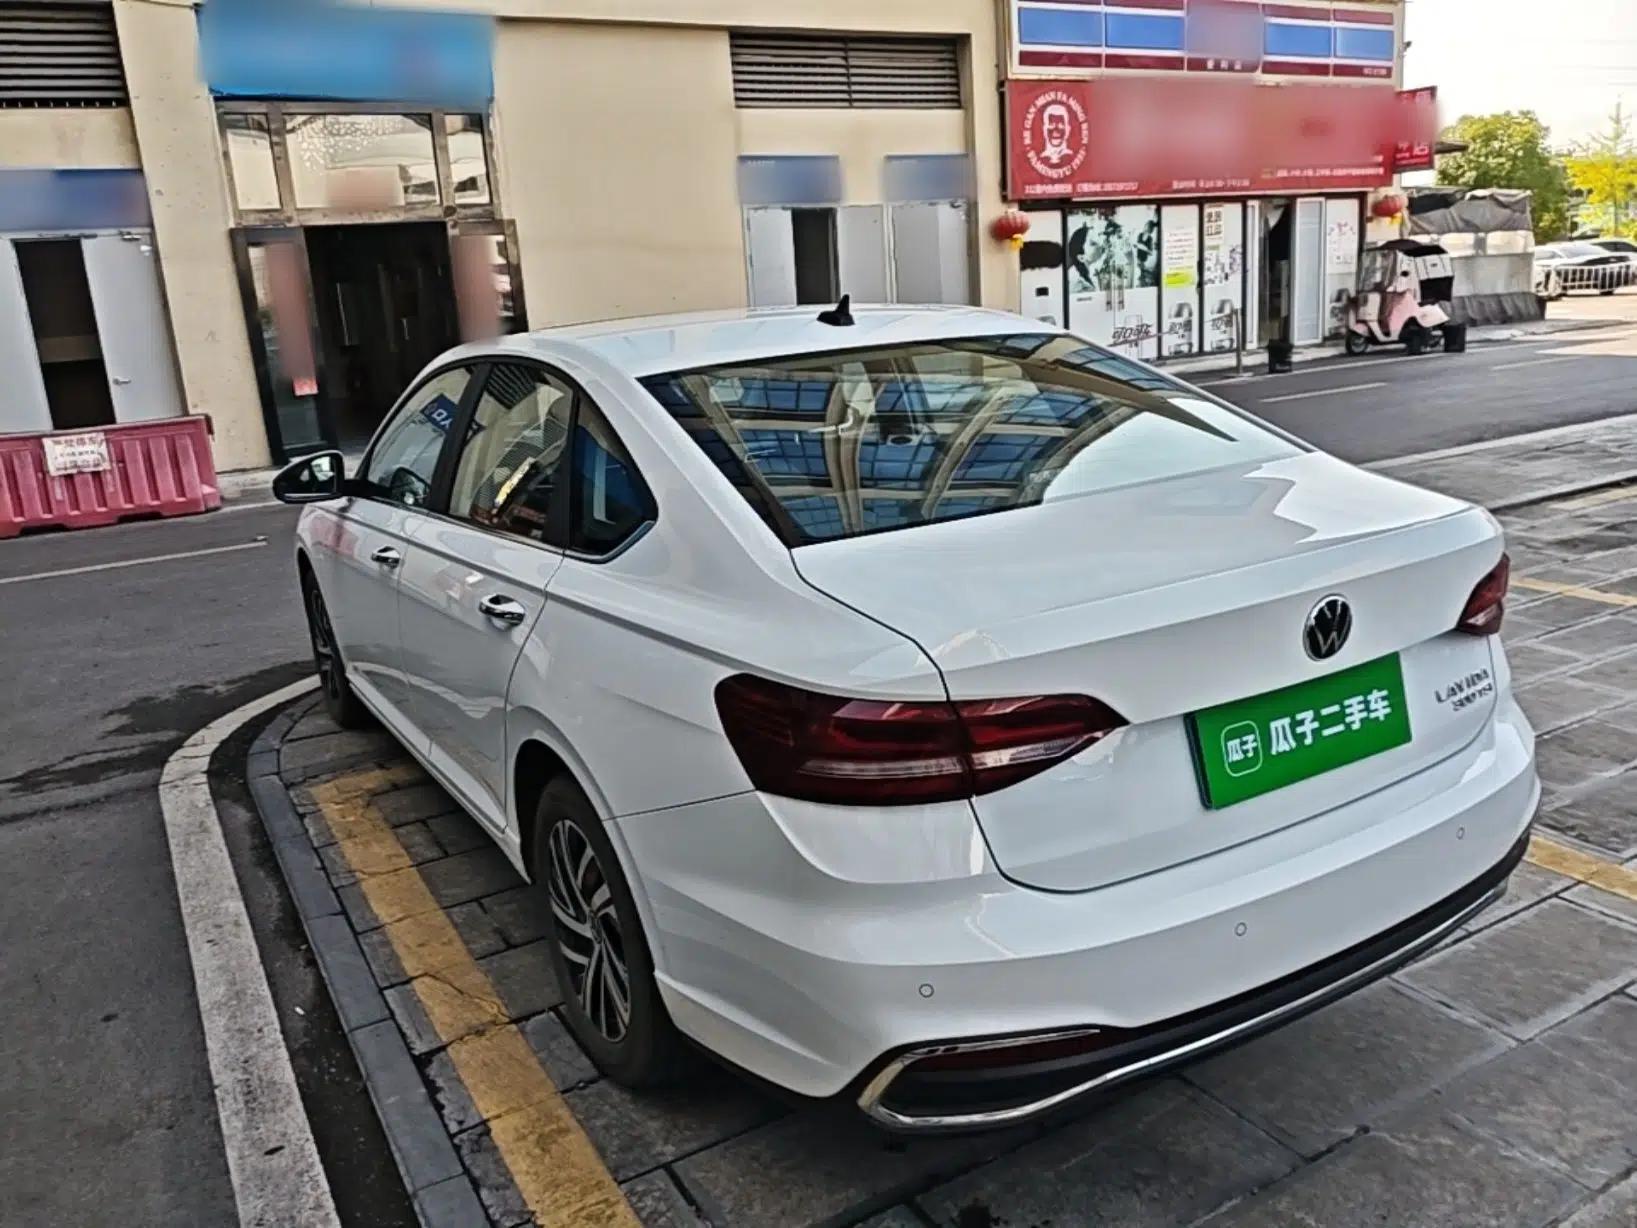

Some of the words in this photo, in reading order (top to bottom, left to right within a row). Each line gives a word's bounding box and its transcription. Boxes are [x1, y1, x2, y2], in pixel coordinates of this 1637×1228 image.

[1227, 734, 1257, 763] 瓜子
[1270, 689, 1391, 755] 瓜子二手车
